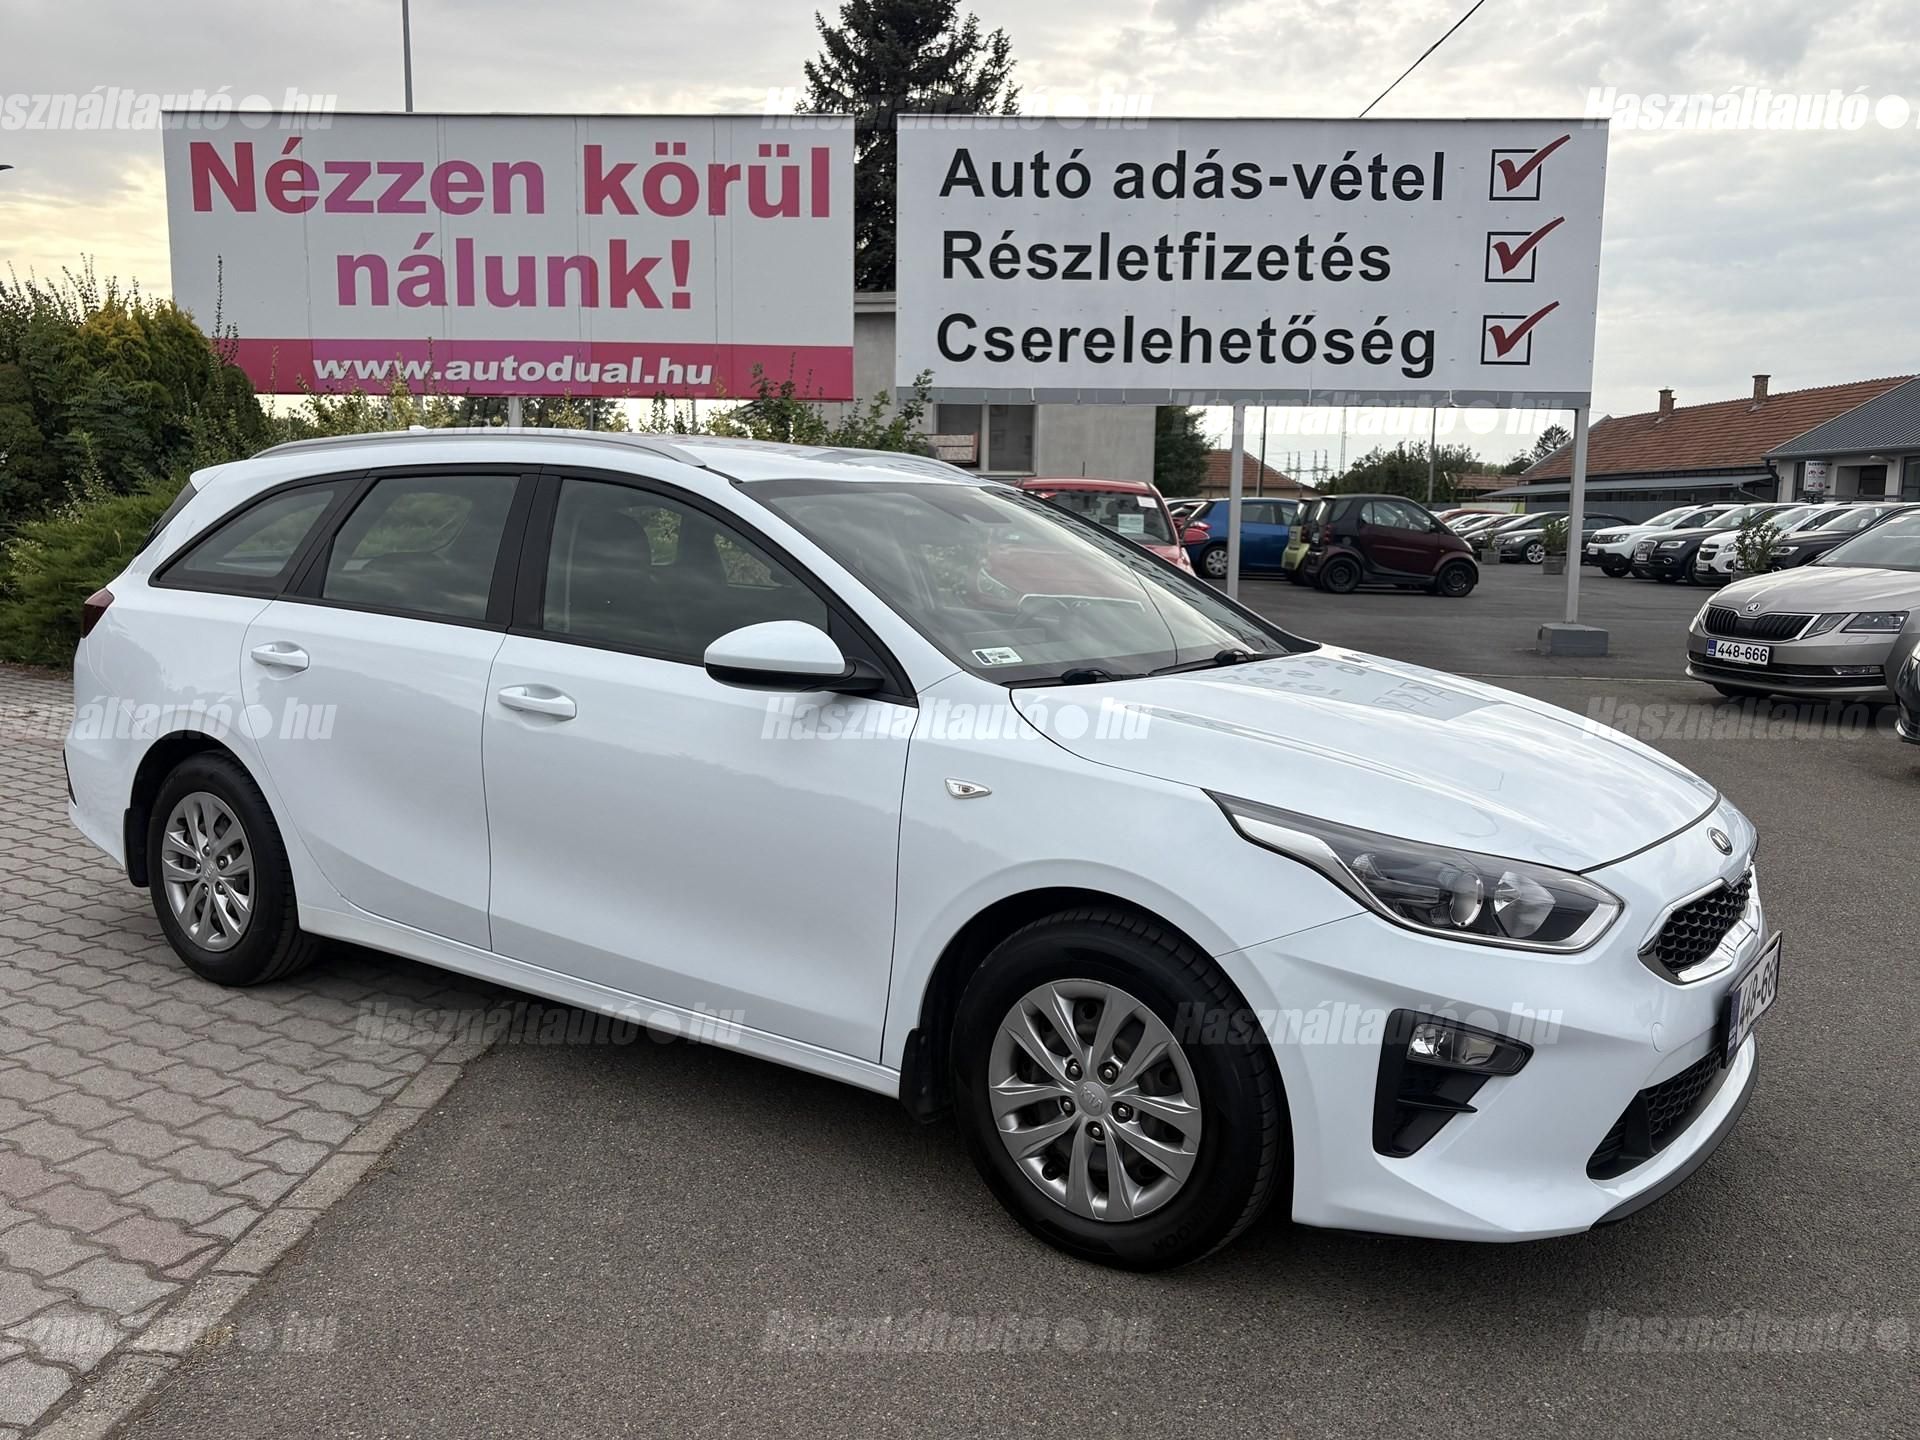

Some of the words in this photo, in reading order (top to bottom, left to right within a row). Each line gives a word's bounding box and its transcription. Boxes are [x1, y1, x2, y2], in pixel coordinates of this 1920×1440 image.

[191, 137, 544, 215] Nézzen
[584, 142, 829, 218] körül
[939, 148, 1091, 199] Autó
[1113, 148, 1445, 202] adás-vétel
[337, 233, 690, 309] nálunk!
[943, 229, 1391, 282] Részletfizetés
[313, 356, 712, 385] www.autodual.hu
[937, 312, 1435, 379] Cserelehetőség
[1717, 642, 1768, 662] 448-666
